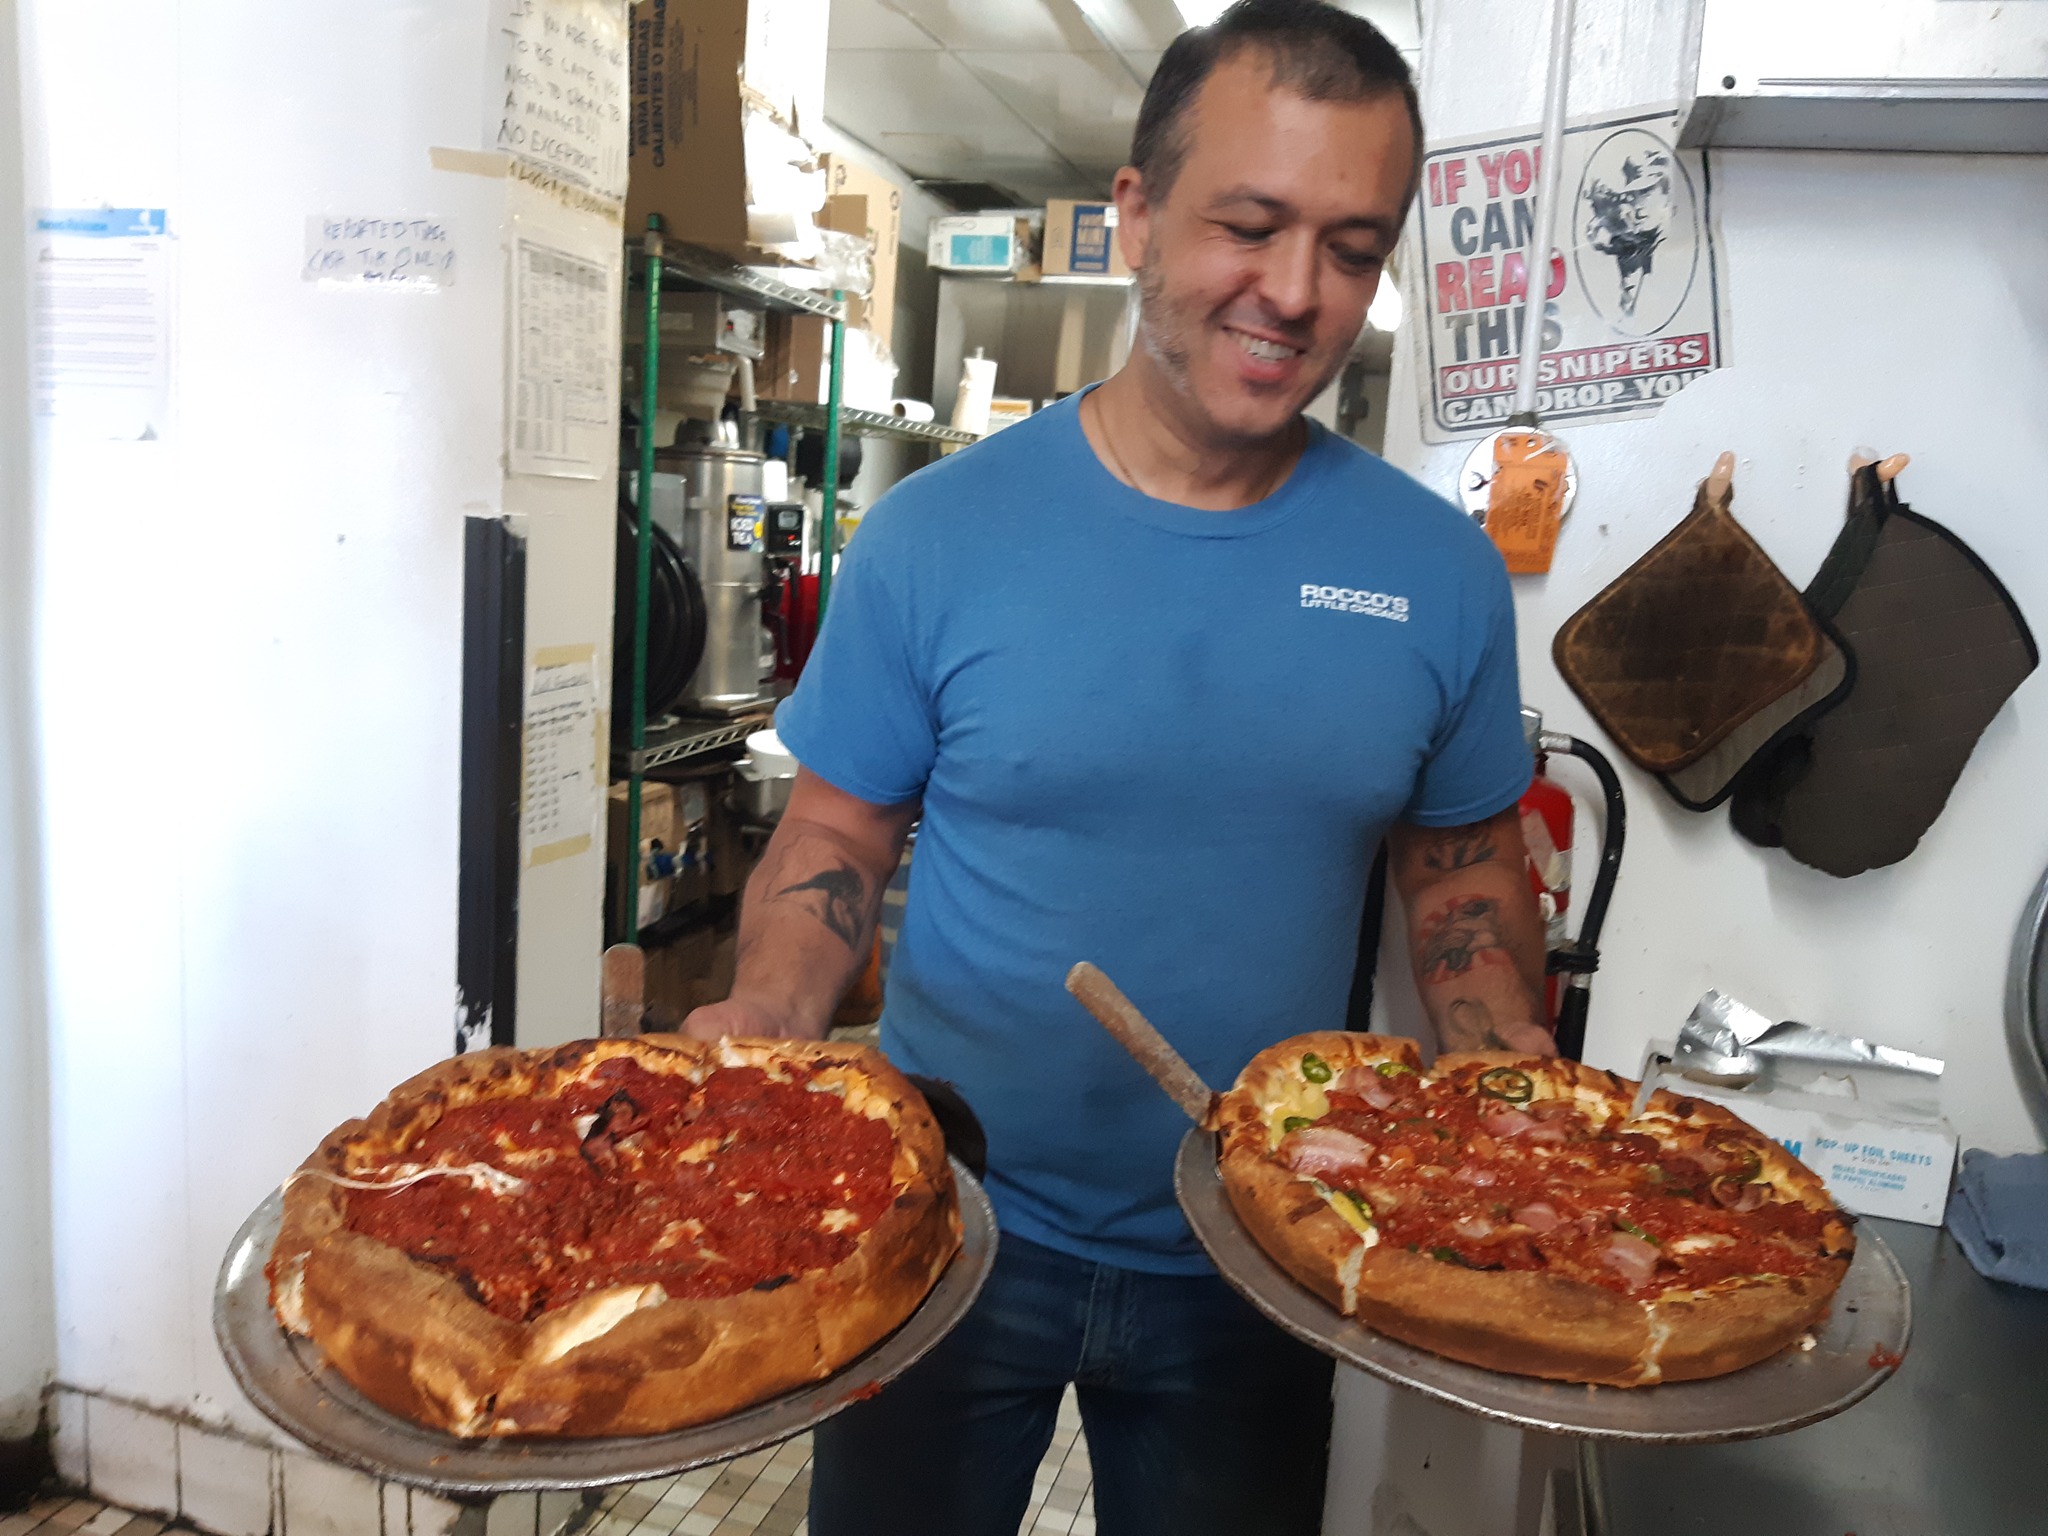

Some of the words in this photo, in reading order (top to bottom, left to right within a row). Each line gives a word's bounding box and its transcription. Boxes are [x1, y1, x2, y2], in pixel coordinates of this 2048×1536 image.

[637, 18, 650, 95] BEBIDAS
[497, 118, 526, 145] NO
[637, 101, 650, 147] PARA
[651, 71, 665, 168] CALIENTES
[1429, 159, 1466, 207] IF
[1445, 363, 1520, 394] OUR
[1539, 340, 1704, 383] SNIPERS
[1535, 381, 1625, 413] DROP
[1300, 583, 1409, 613] ROCCO'S
[1300, 598, 1349, 611] LITTLE
[1349, 604, 1409, 622] CHICAGO
[1815, 1137, 1859, 1152] POP-UP
[1862, 1144, 1885, 1159] FOIL
[1889, 1149, 1932, 1166] SHEETS
